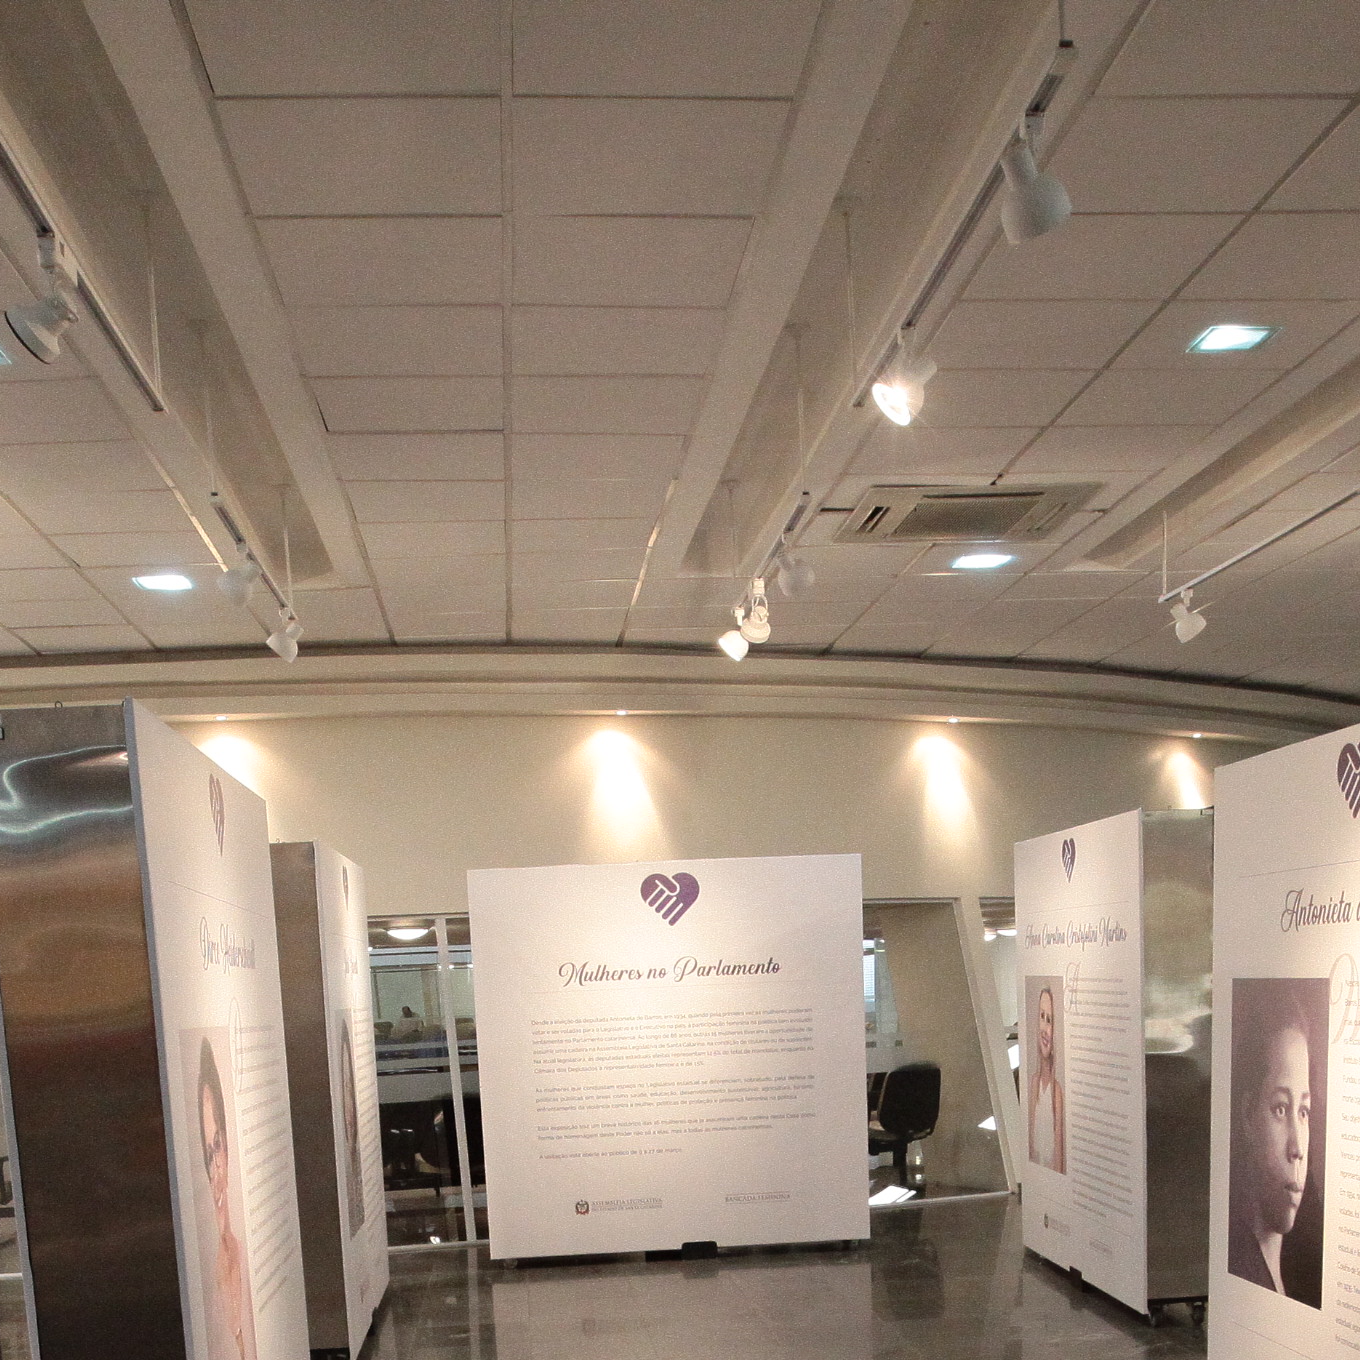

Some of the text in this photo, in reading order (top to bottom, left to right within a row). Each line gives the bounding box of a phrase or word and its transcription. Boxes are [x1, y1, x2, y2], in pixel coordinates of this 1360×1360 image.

[1280, 887, 1353, 932] Antonieta
[558, 955, 783, 987] Mulheres no Parlamento
